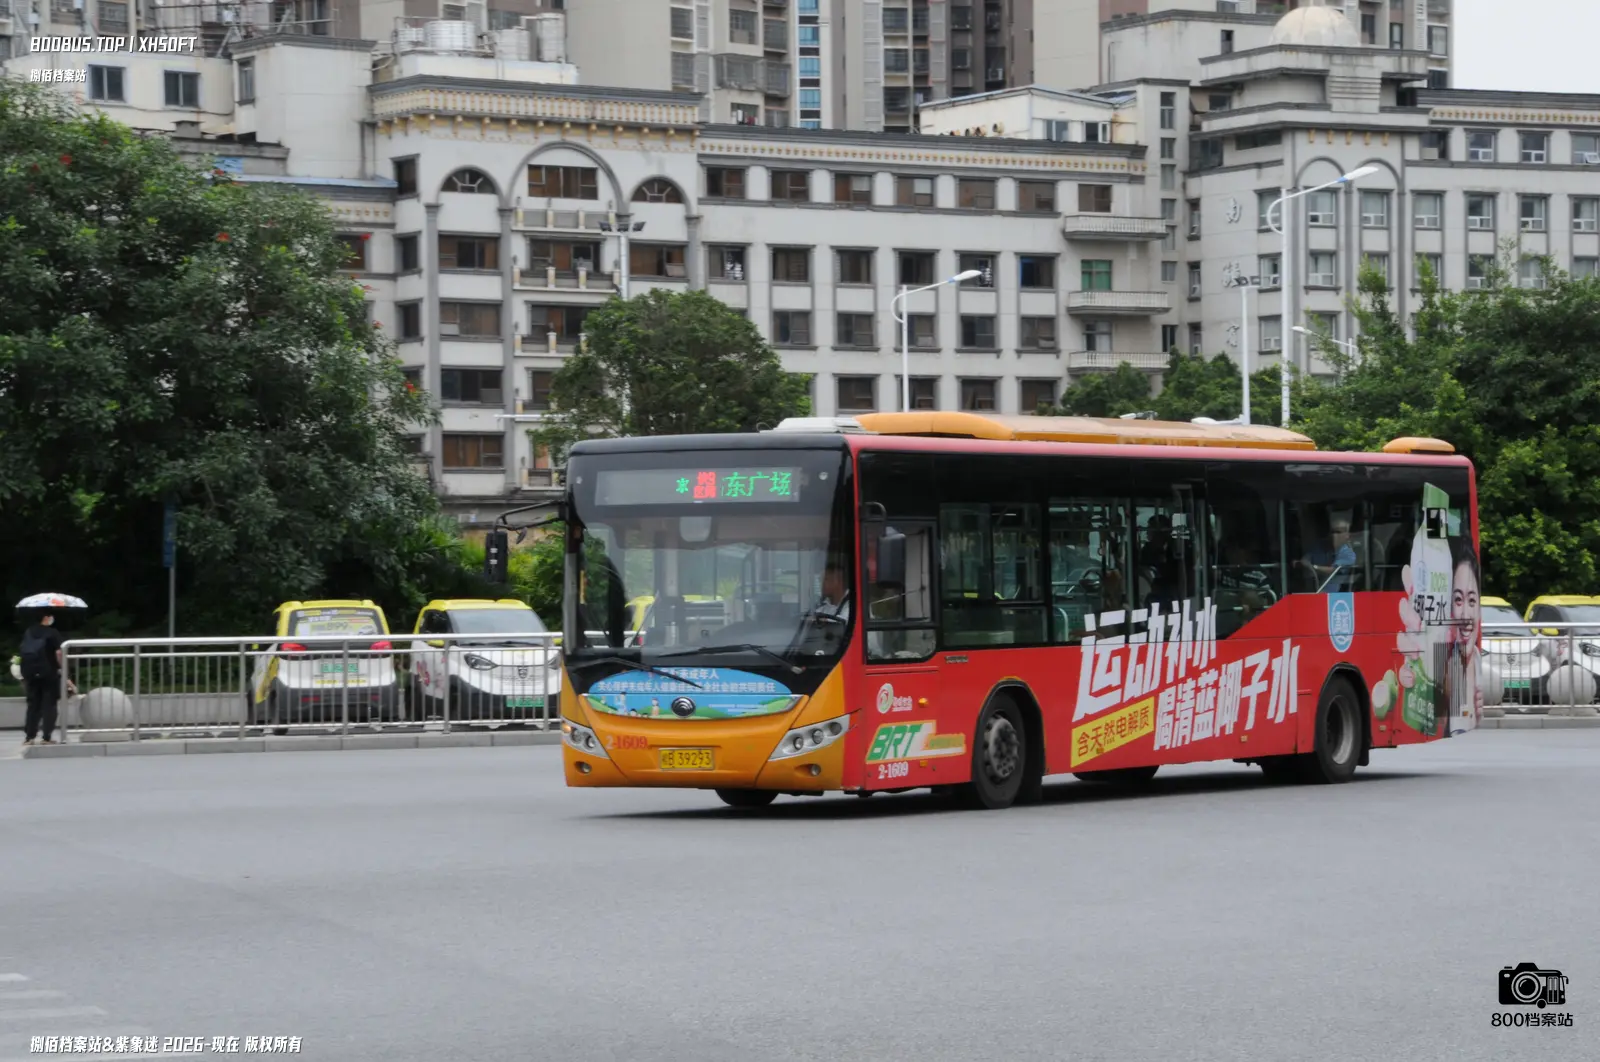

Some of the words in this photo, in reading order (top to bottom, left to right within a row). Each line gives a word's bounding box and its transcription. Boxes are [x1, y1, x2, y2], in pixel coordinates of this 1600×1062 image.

[722, 471, 792, 497] 东广场
[1071, 596, 1218, 723] 运动补水
[605, 734, 649, 750] 2-1609
[867, 723, 924, 761] BRT
[1077, 706, 1150, 757] 含天然电解质
[878, 761, 908, 780] 2-1609
